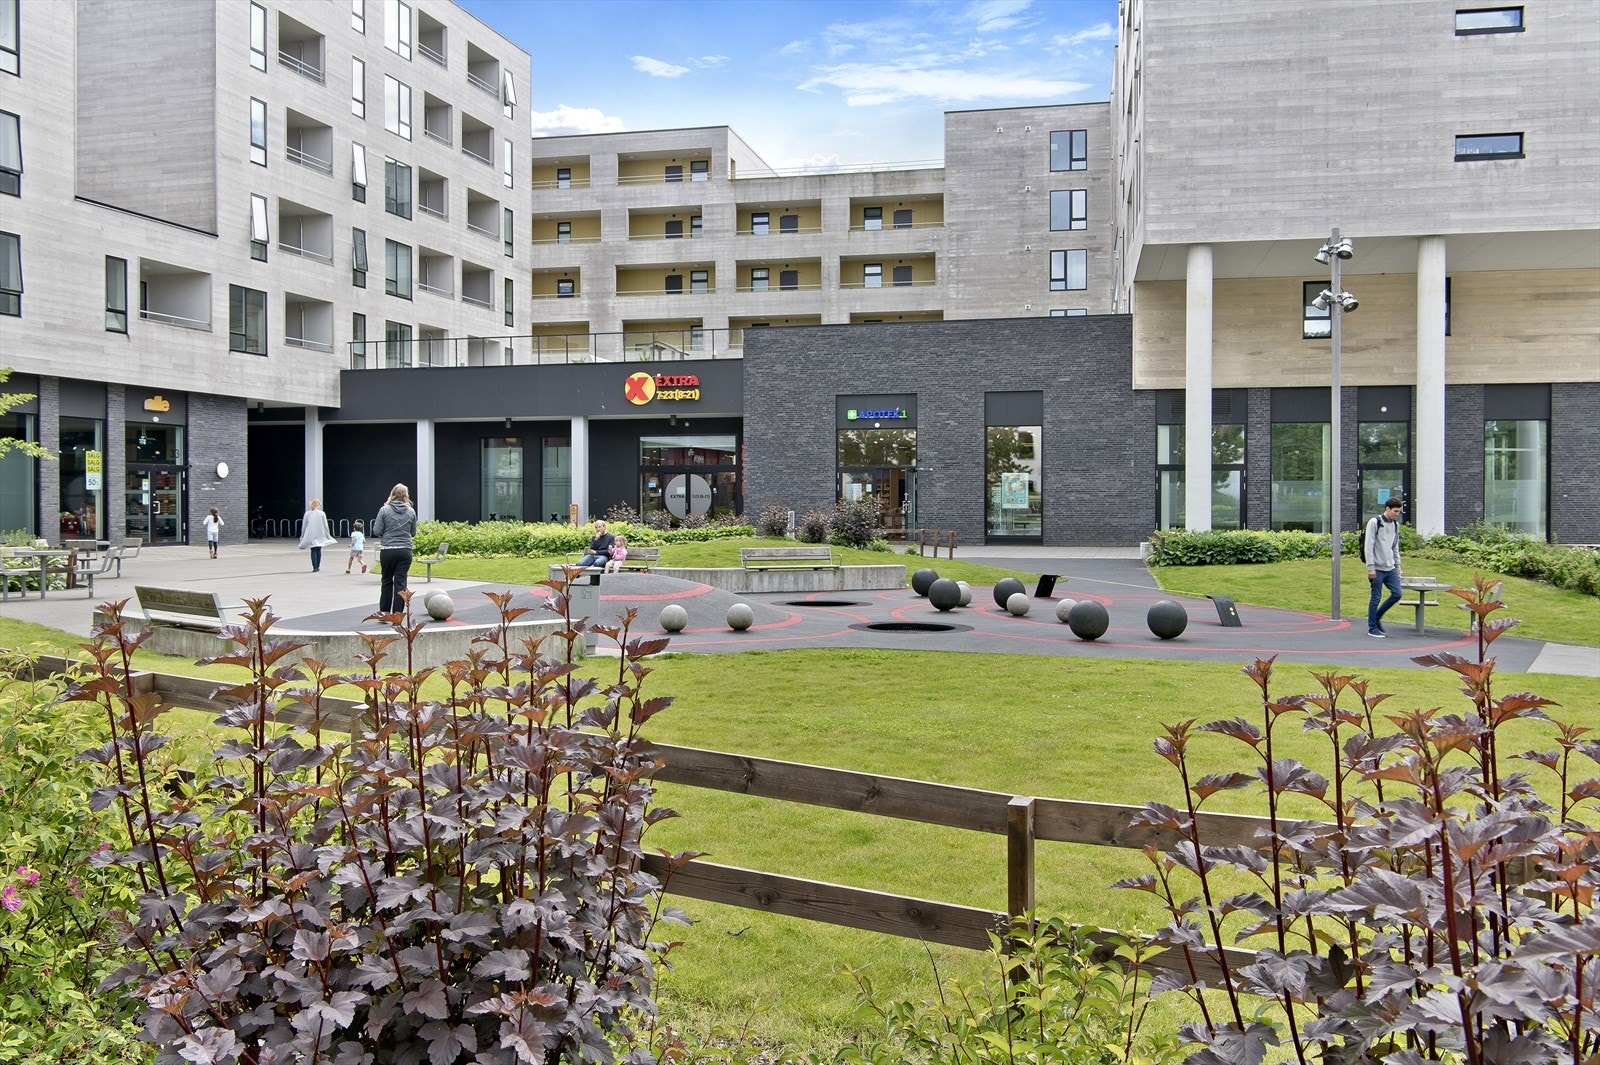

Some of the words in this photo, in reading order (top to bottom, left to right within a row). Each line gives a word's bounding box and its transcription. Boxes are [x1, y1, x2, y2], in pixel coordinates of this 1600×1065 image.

[655, 375, 699, 387] EXTRA
[859, 410, 899, 419] APOTEK
[901, 410, 907, 418] 1
